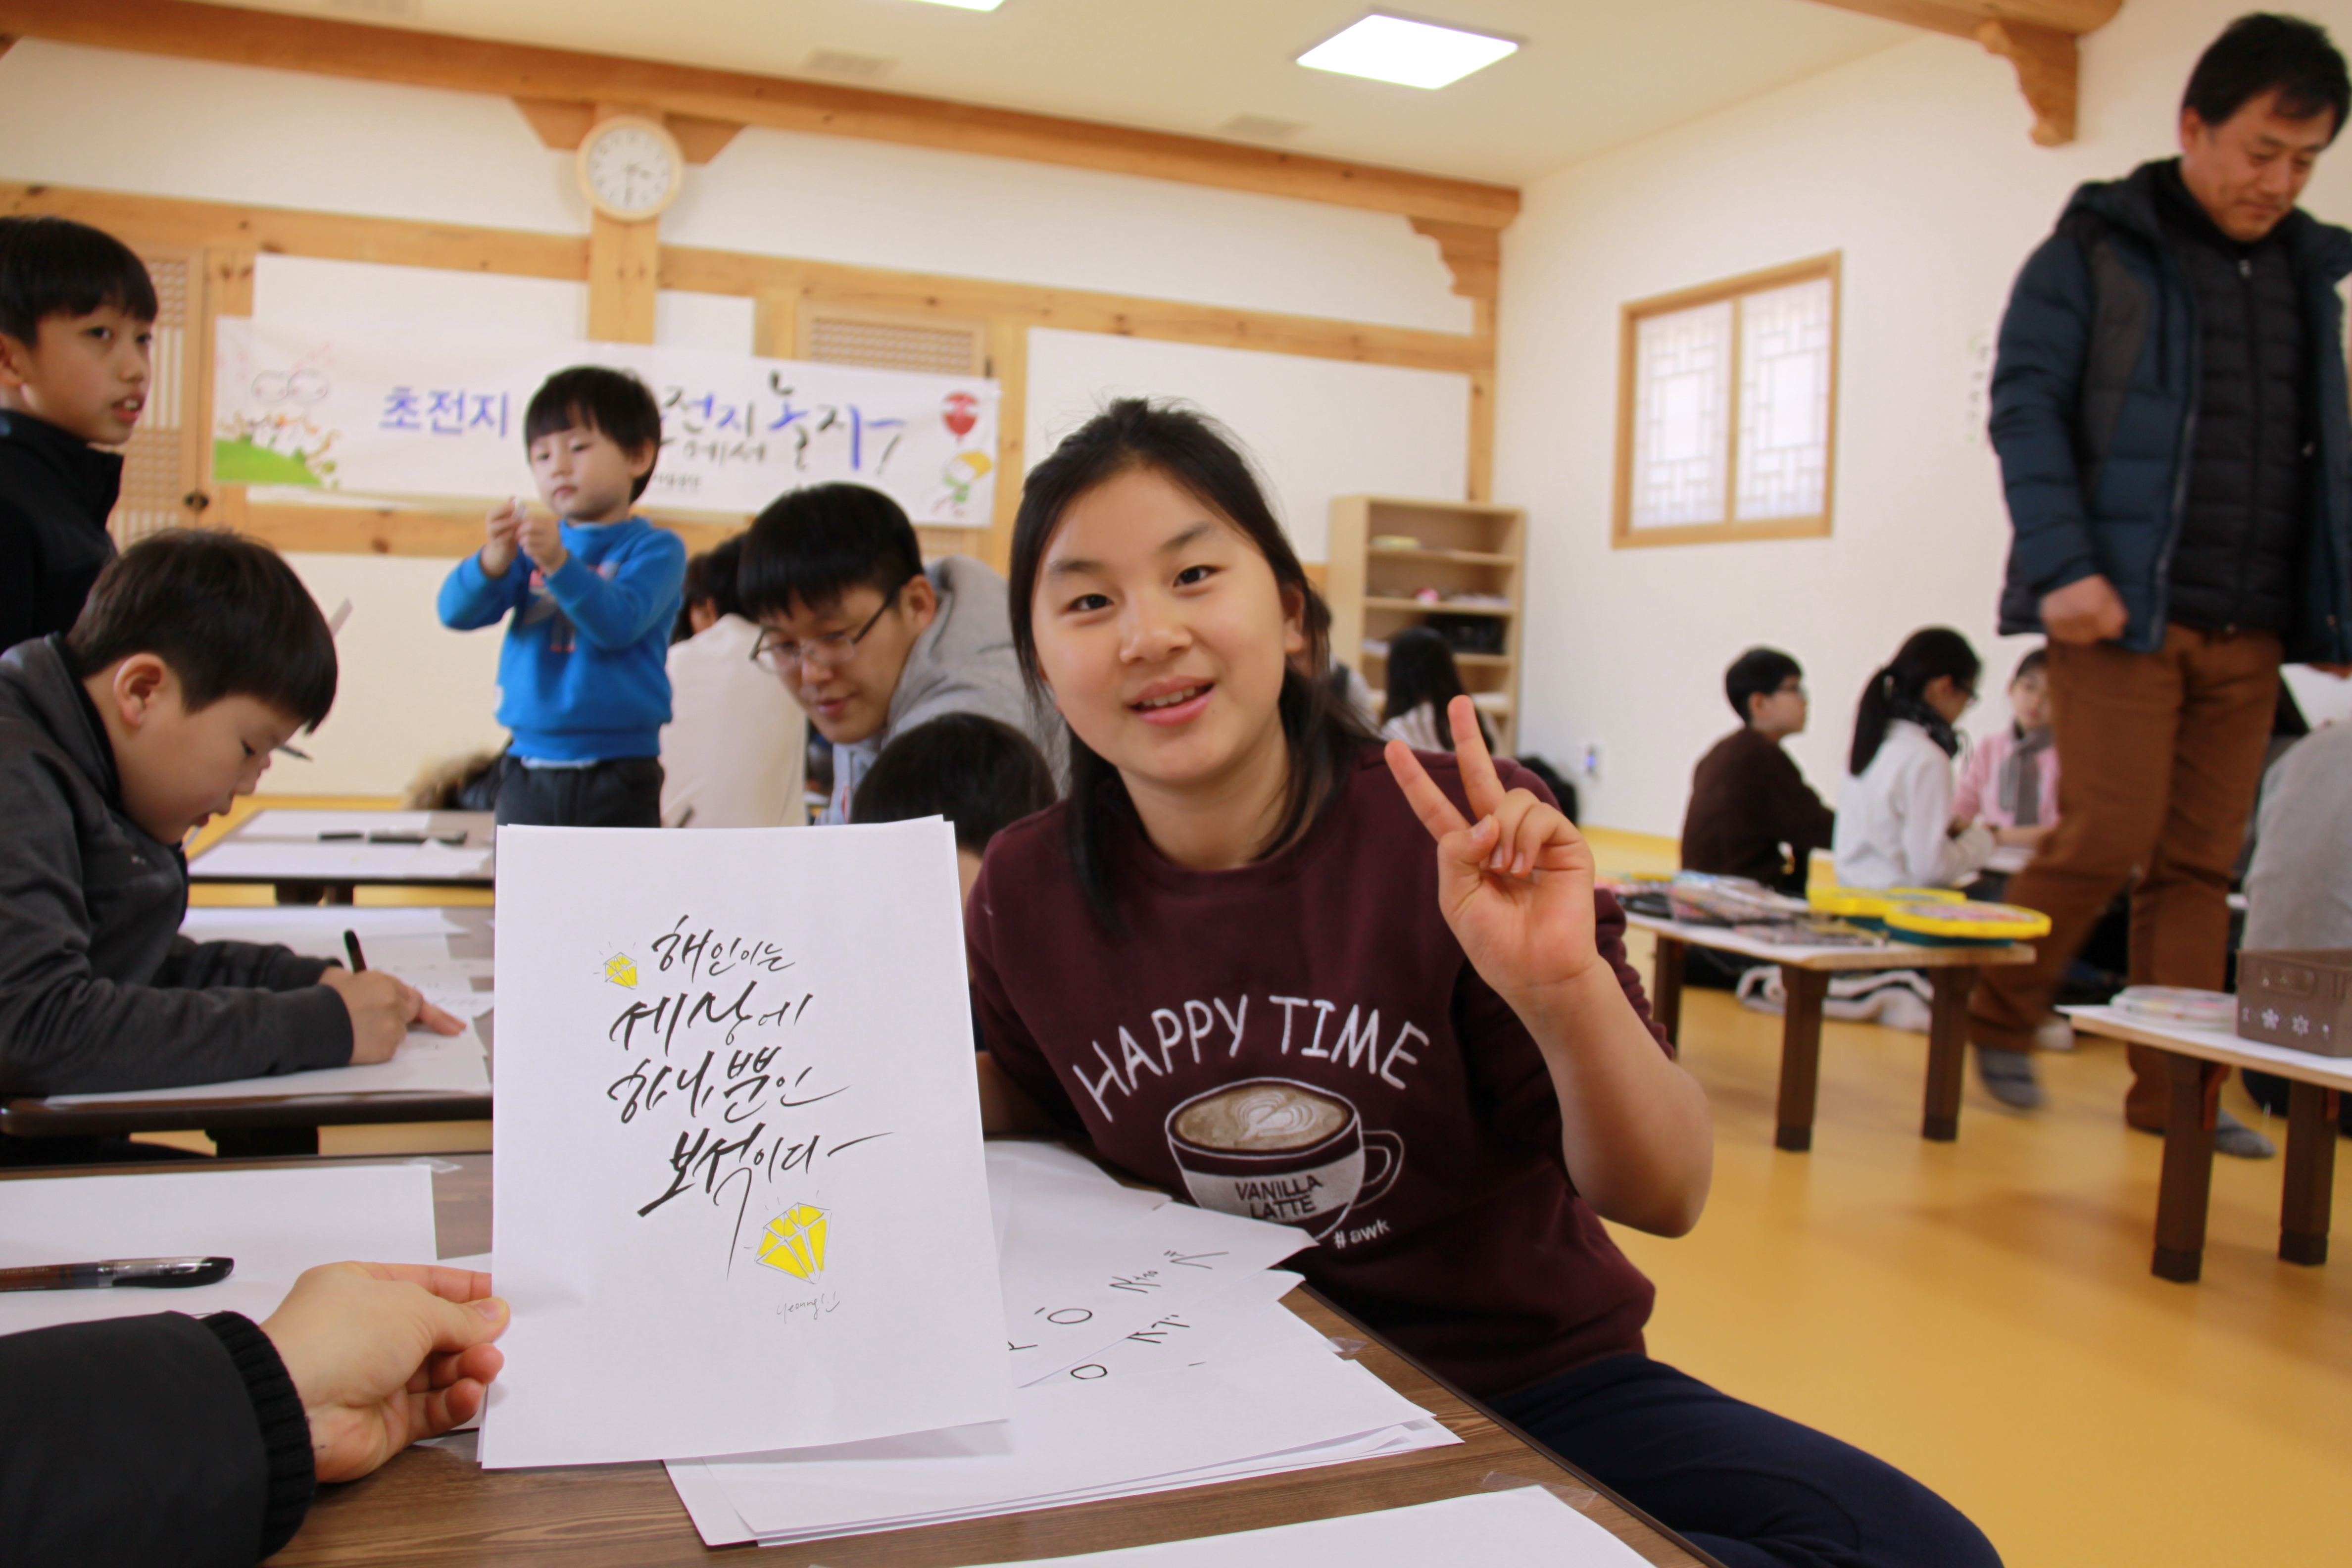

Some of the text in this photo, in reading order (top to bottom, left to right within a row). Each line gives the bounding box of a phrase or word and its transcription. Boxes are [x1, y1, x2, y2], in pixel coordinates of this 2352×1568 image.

[379, 386, 509, 439] 초전지
[651, 914, 796, 983] 해인이는
[609, 980, 813, 1057] 세상에
[1073, 993, 1429, 1123] HAPPY TIME
[1235, 1175, 1323, 1201] VANILLA
[1250, 1194, 1317, 1219] LATTE
